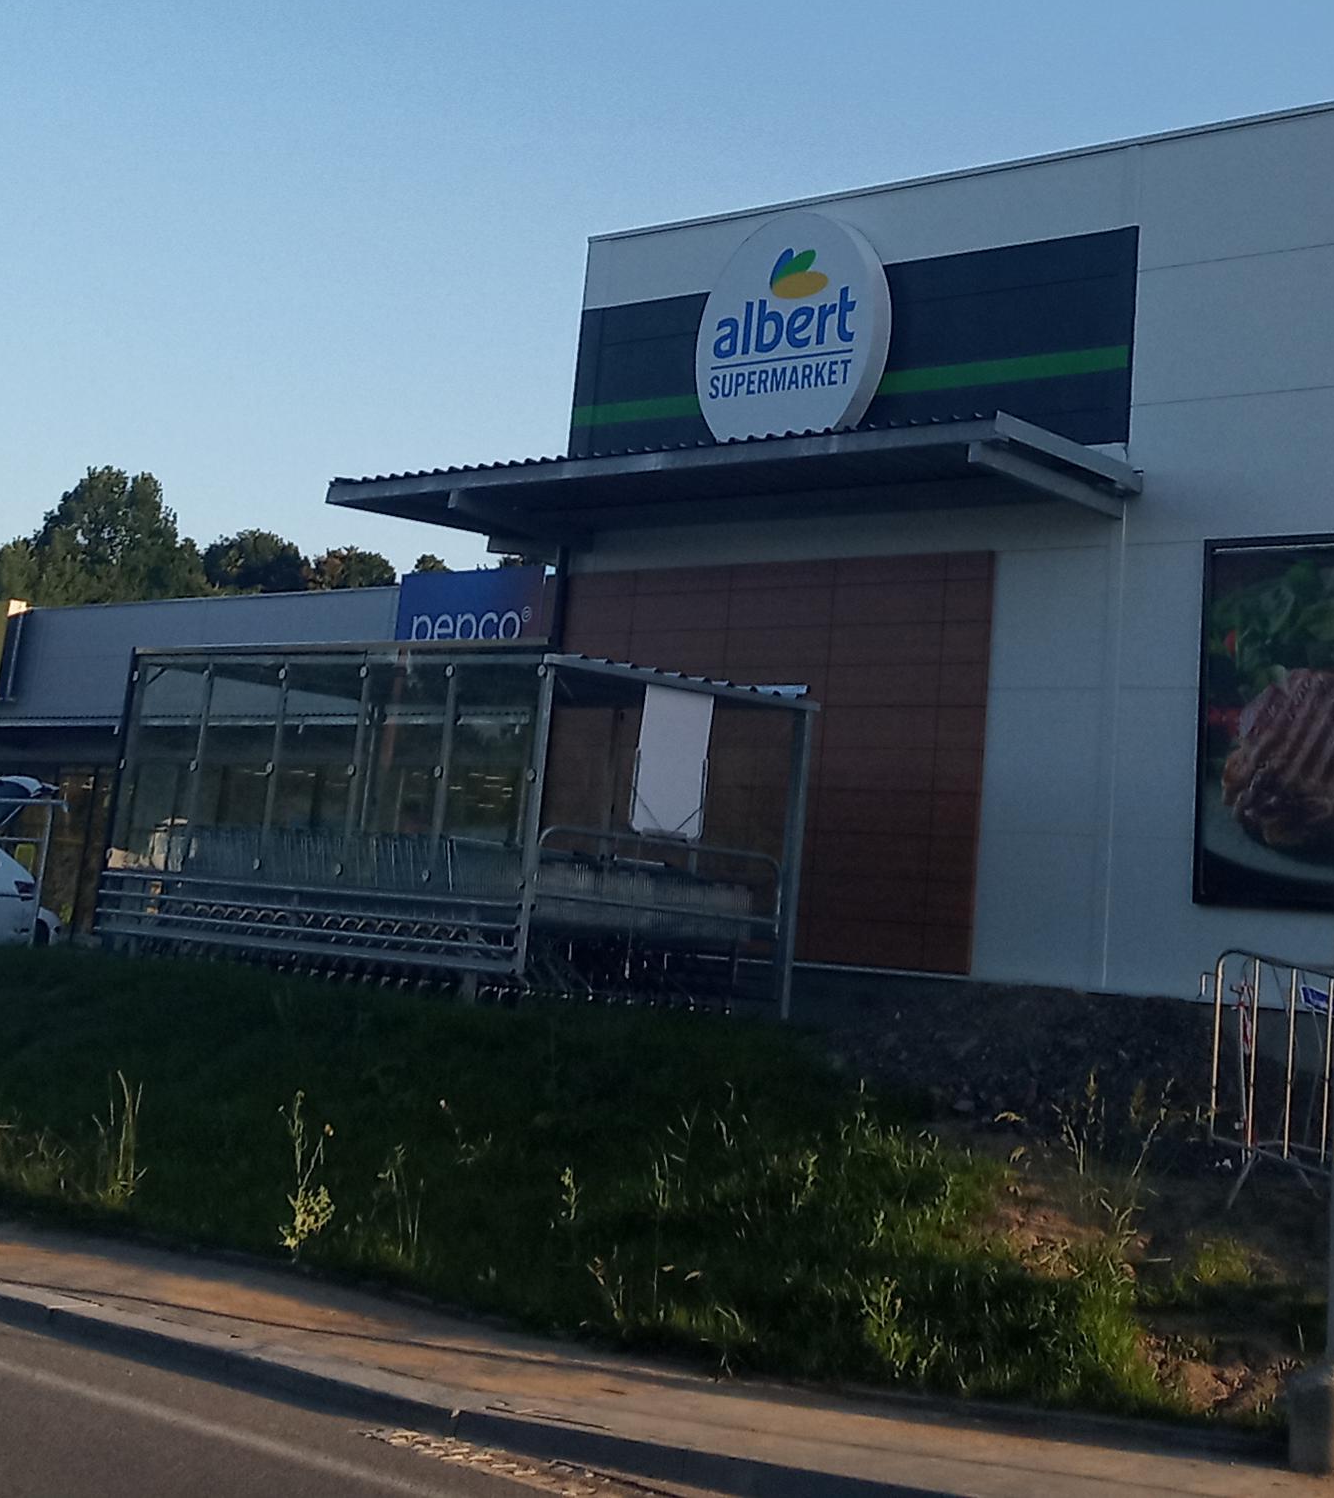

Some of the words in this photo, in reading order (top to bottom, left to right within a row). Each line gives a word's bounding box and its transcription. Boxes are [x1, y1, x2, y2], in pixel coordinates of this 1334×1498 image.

[713, 286, 856, 359] albert
[708, 359, 852, 399] SUPERMARKET
[410, 610, 521, 641] pepco
